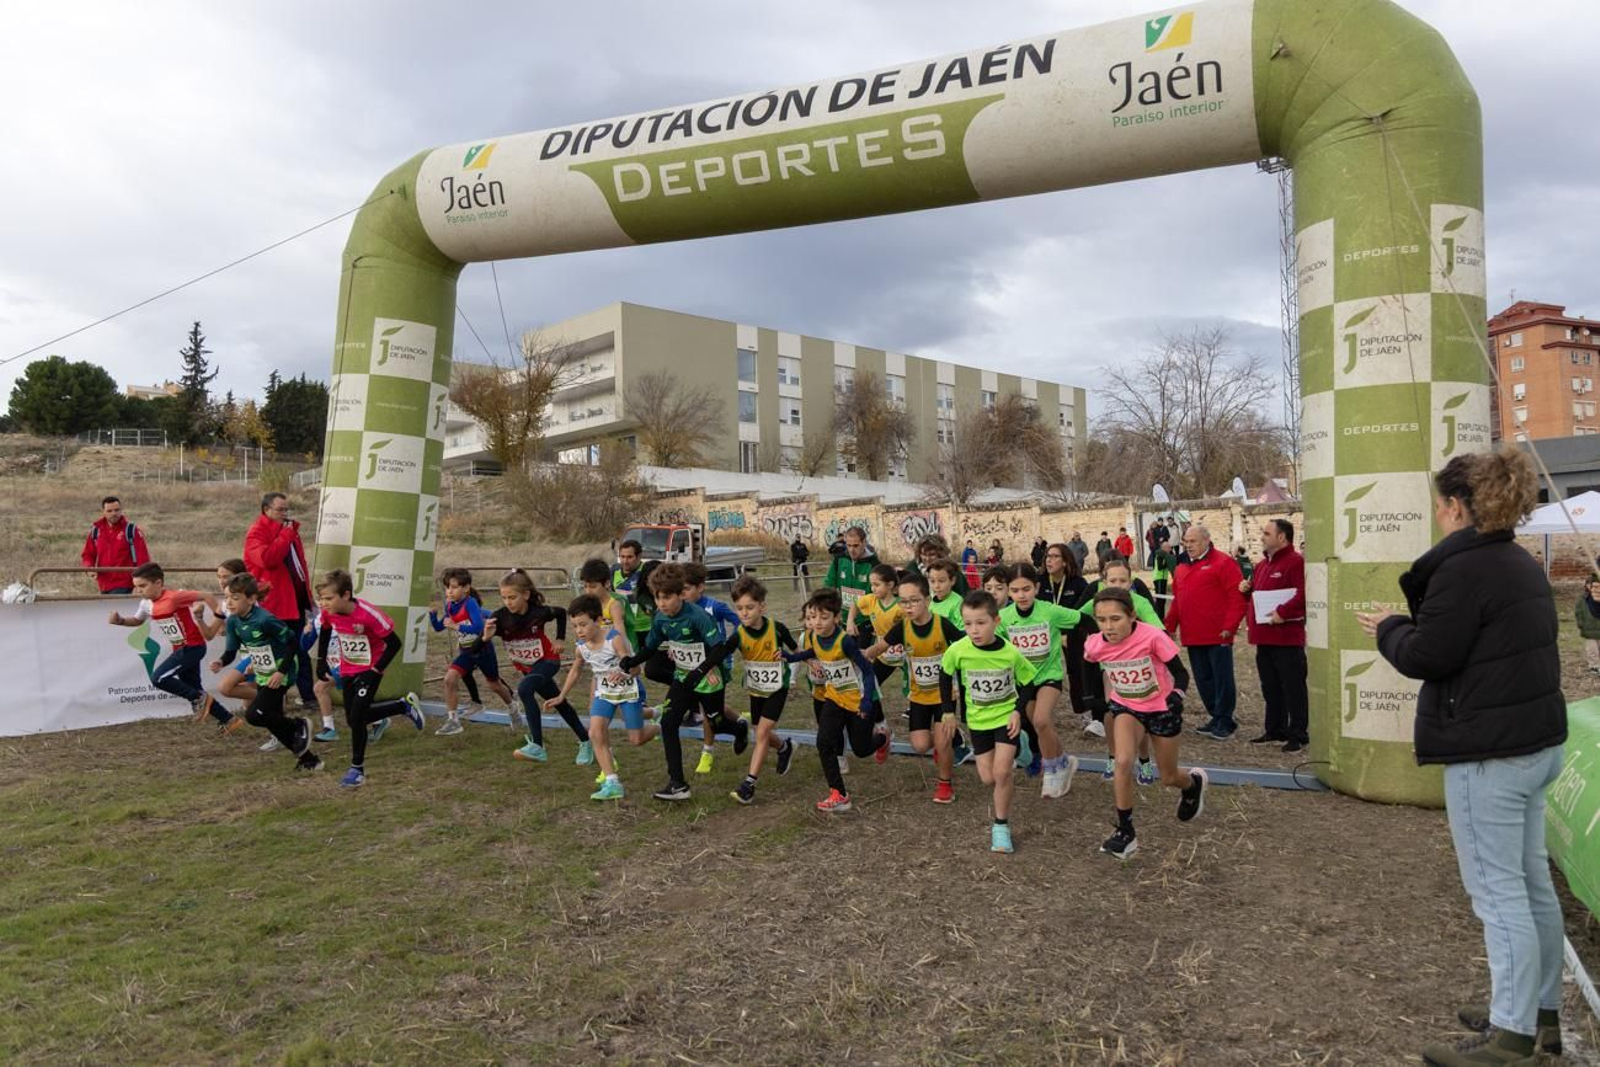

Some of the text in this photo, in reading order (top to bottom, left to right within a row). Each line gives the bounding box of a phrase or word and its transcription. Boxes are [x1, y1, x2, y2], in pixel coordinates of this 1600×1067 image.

[1109, 52, 1222, 113] Jaén
[540, 39, 1057, 160] DIPUTACIÓN DE JAÉN
[1170, 100, 1224, 118] interior
[613, 113, 946, 202] DEPORTES
[440, 173, 505, 213] Jaén
[478, 208, 508, 220] interior
[1343, 422, 1420, 436] DEPORTES
[1360, 512, 1422, 523] DIPUTACIÓN
[1360, 523, 1400, 533] DE JAÉN
[1012, 632, 1048, 648] 4323
[1109, 667, 1152, 685] 4325
[108, 685, 147, 695] Patronato
[972, 674, 1010, 694] 4324
[120, 694, 156, 704] Deportes
[157, 692, 168, 700] de
[1360, 690, 1419, 700] DIPUTACIÓN
[1360, 702, 1400, 711] DE JAÉN
